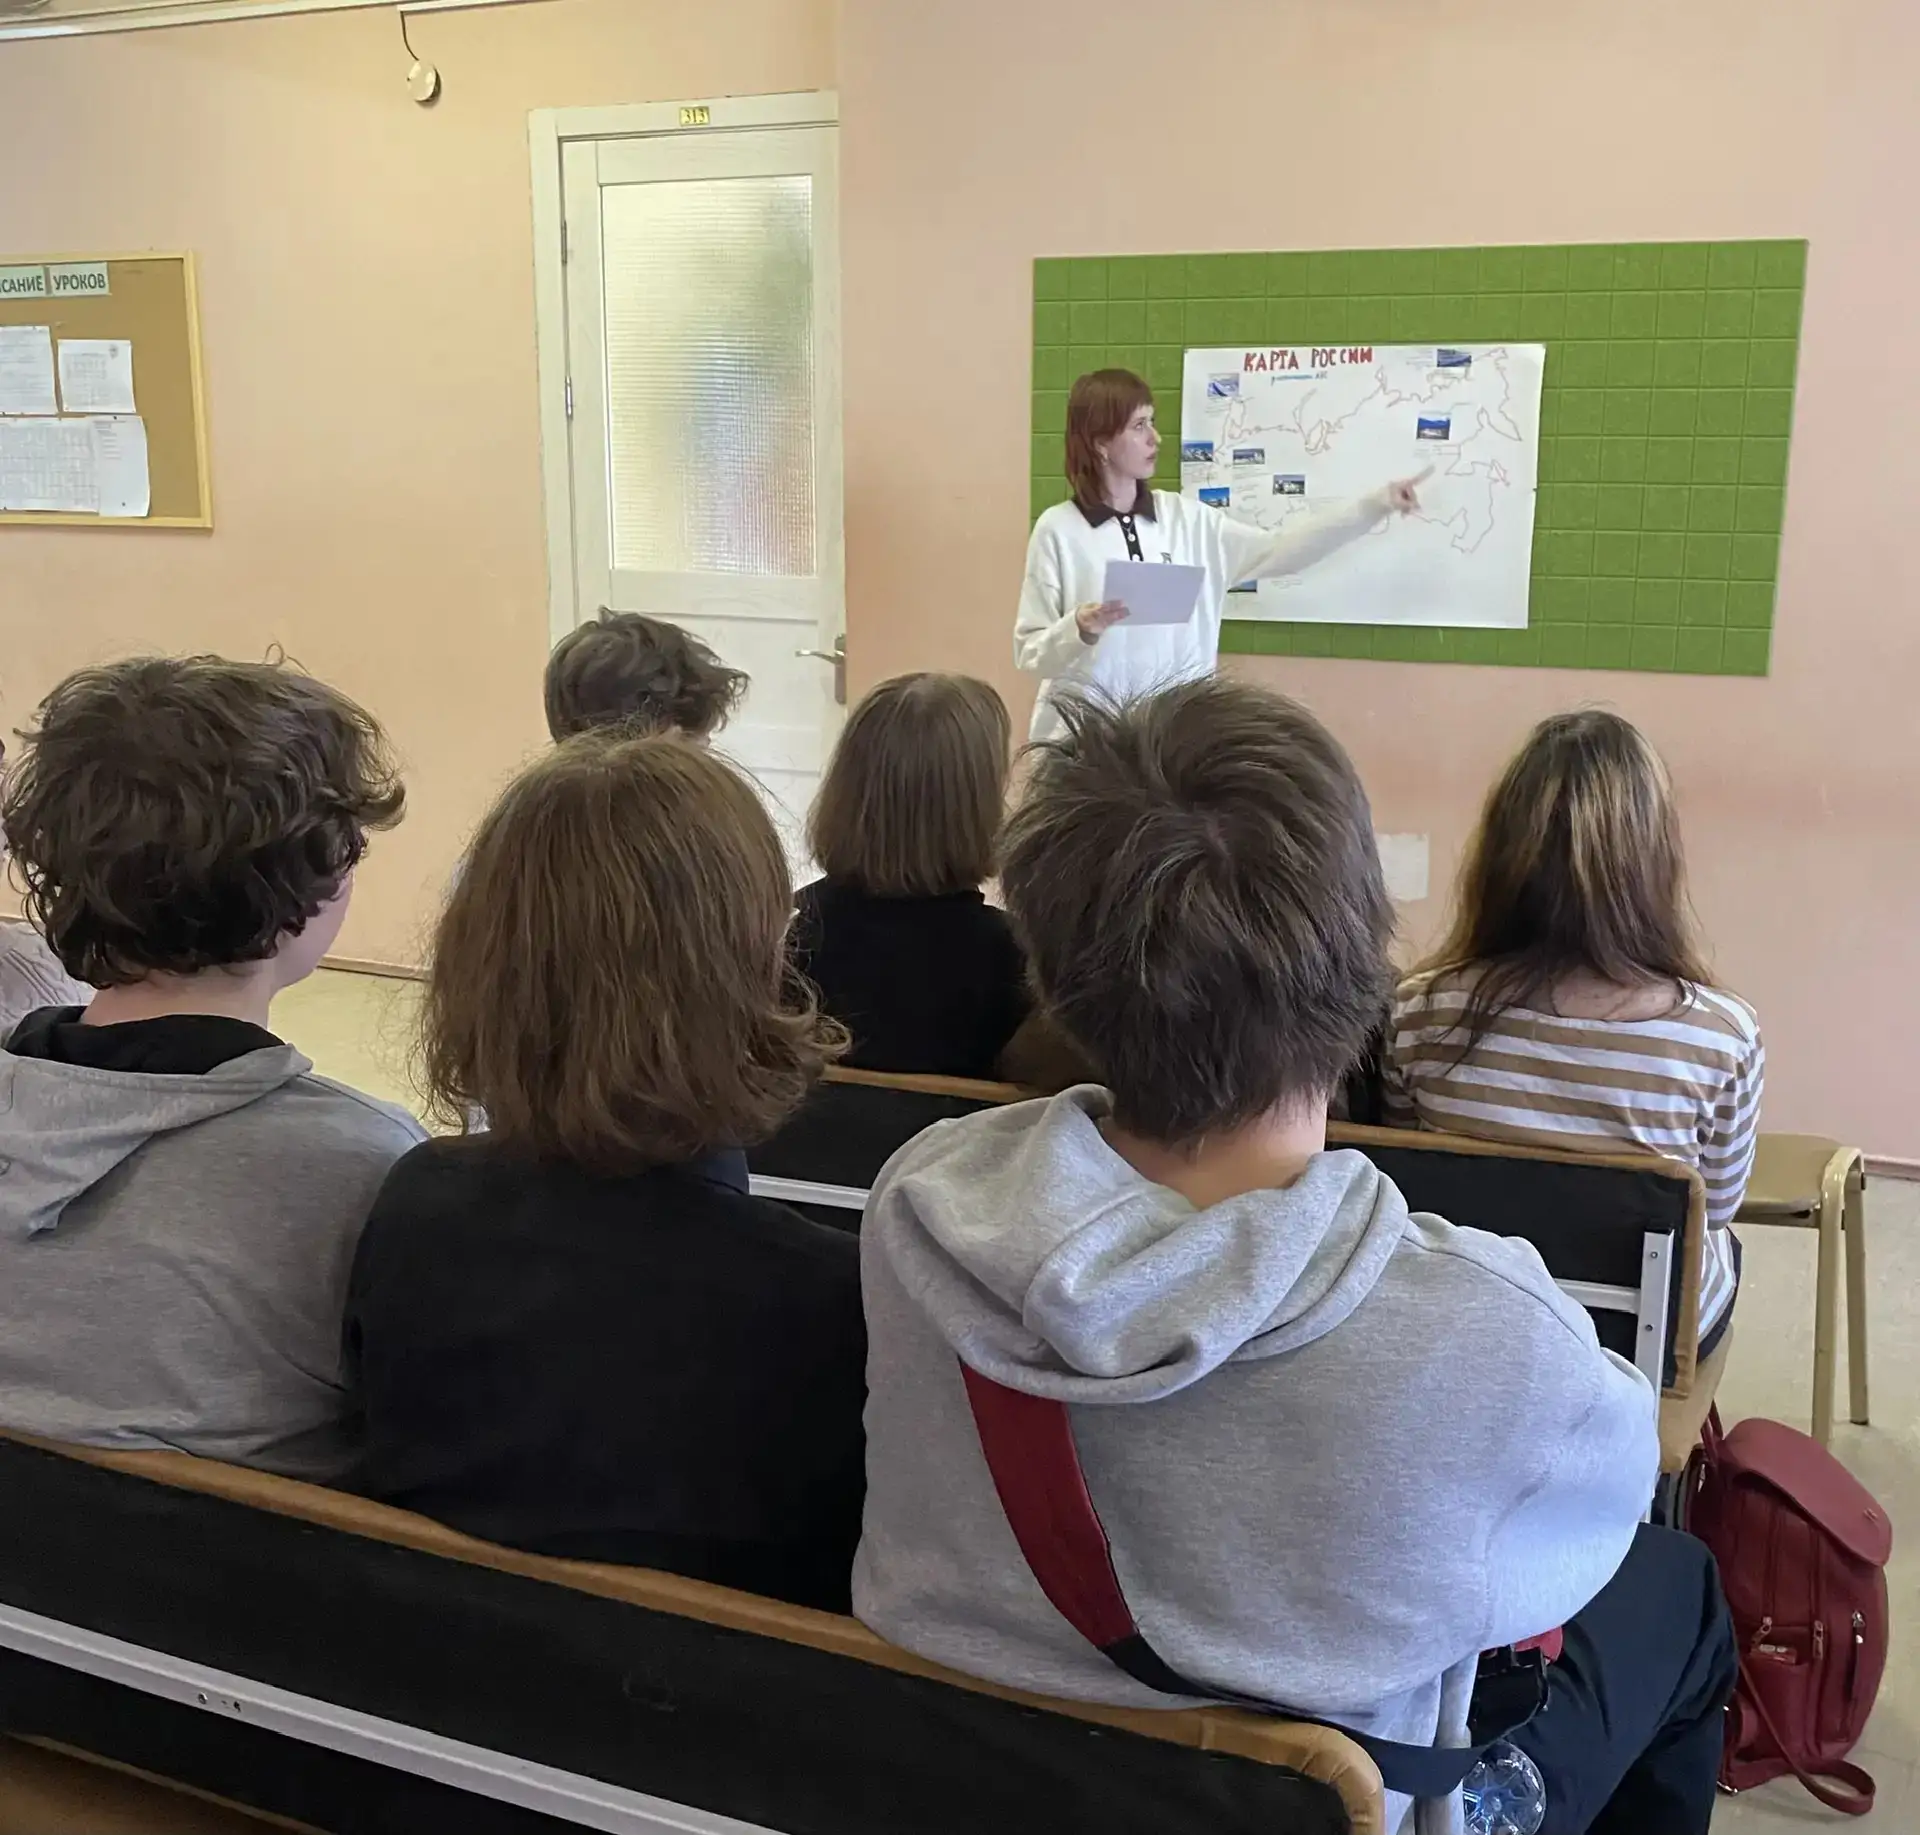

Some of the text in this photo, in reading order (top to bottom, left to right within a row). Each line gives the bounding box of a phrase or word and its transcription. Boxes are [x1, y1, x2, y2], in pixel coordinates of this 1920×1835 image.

[684, 108, 706, 123] 313
[0, 273, 106, 293] САНИЕ УРОКОВ
[1244, 347, 1373, 371] КАРТА РОССИИ
